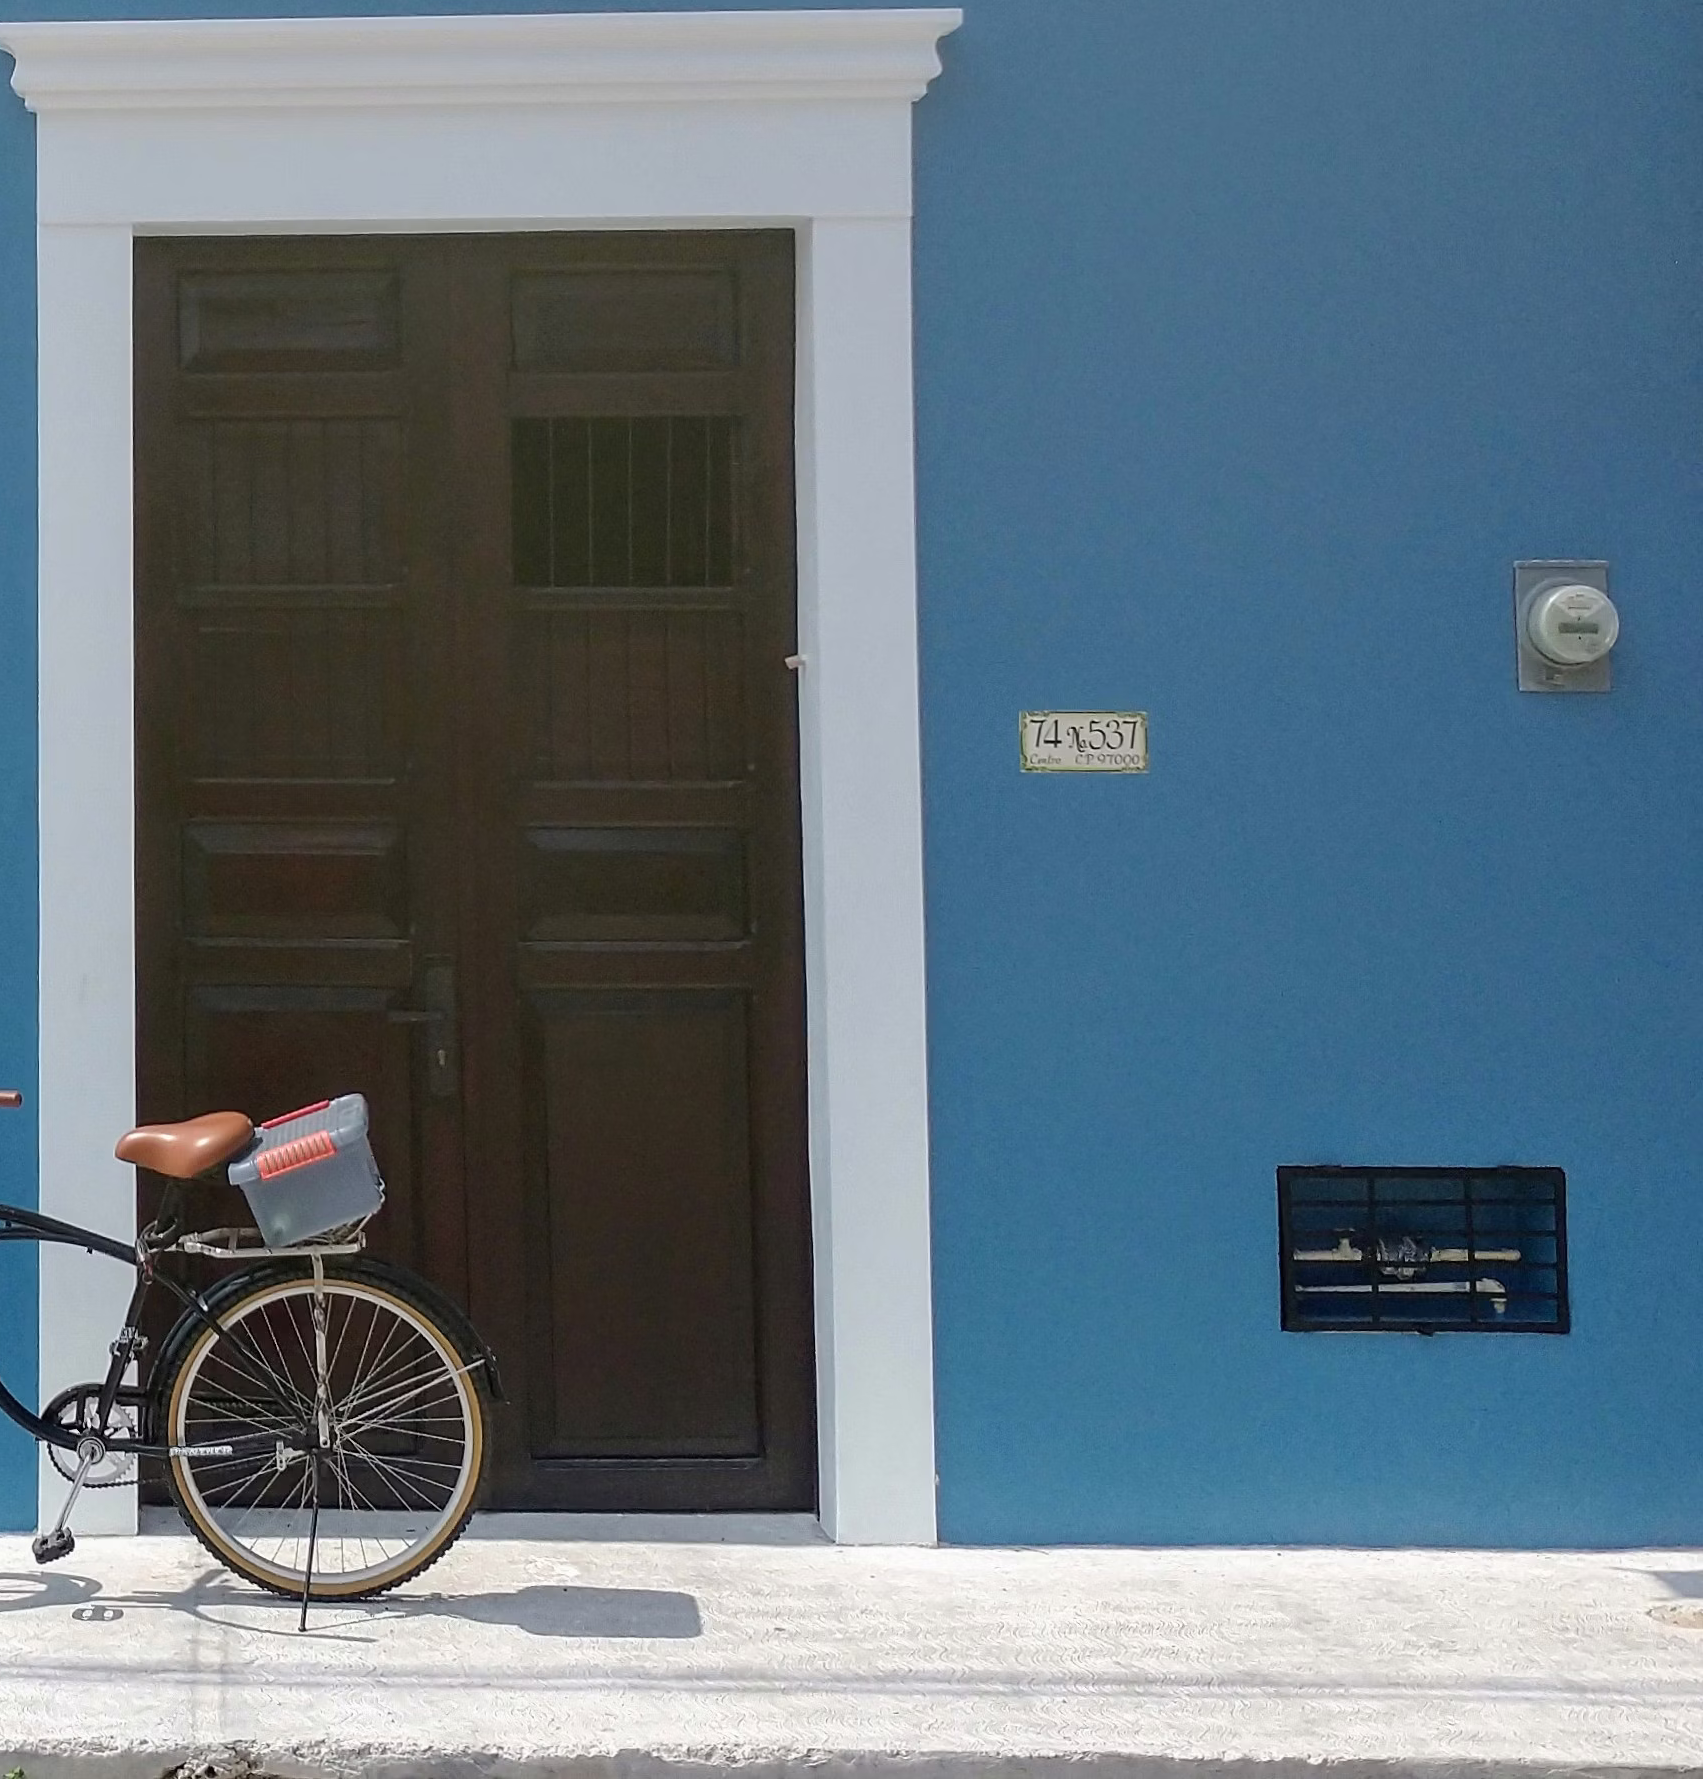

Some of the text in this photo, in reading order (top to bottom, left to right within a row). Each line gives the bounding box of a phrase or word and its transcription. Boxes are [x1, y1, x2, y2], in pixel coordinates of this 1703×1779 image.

[1030, 719, 1062, 748] 74
[1089, 719, 1138, 750] 537
[1097, 753, 1140, 766] 97000
